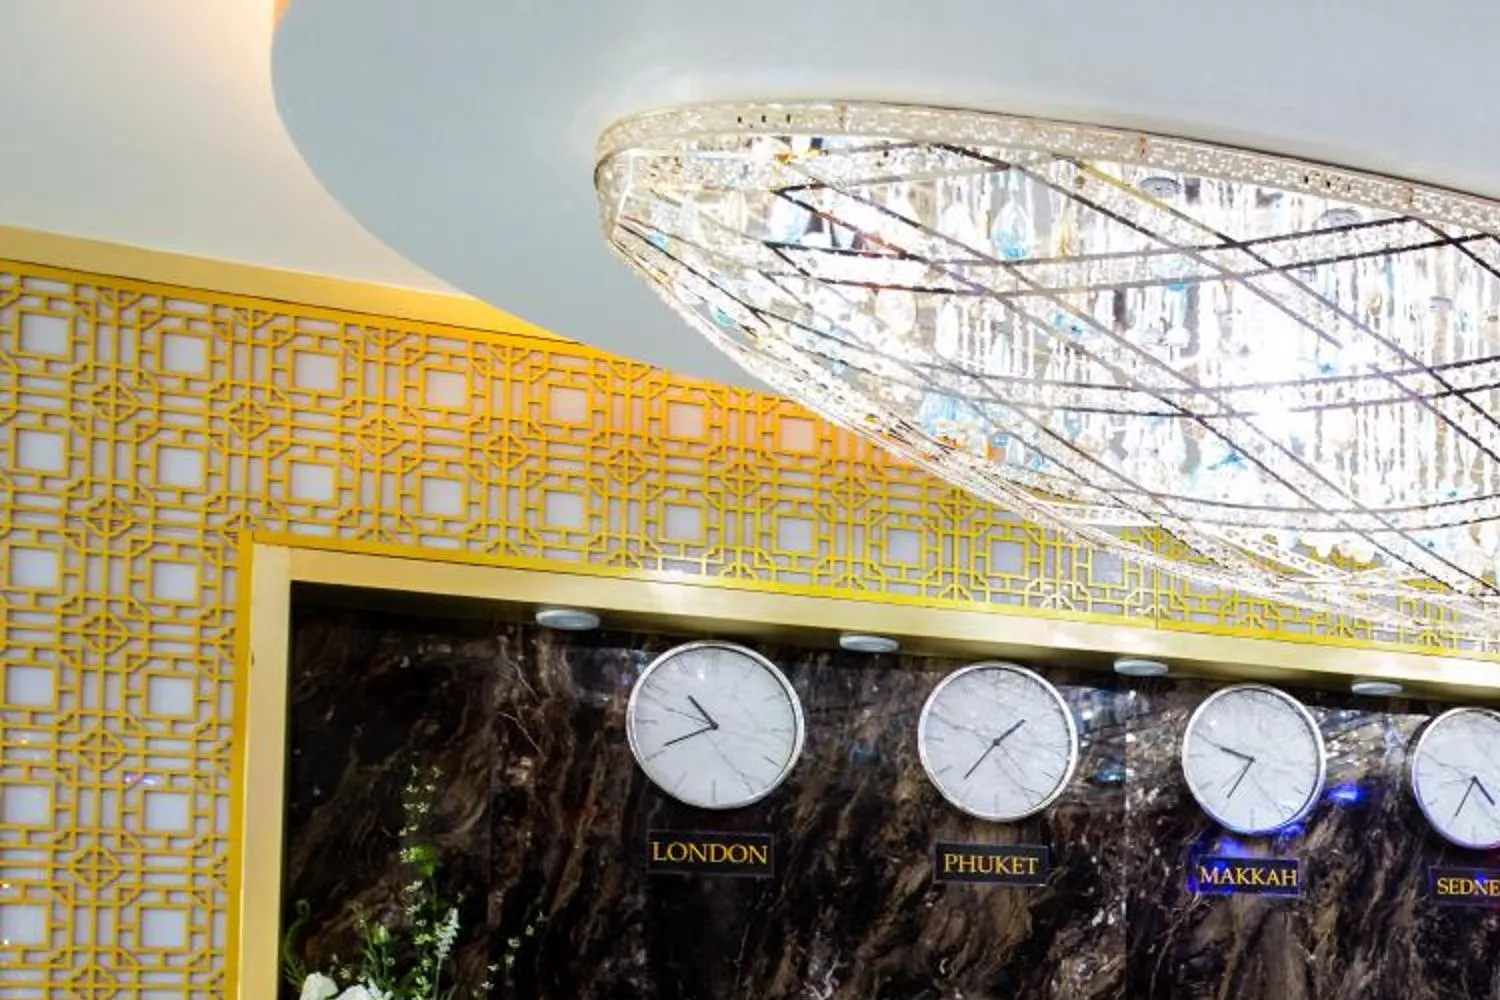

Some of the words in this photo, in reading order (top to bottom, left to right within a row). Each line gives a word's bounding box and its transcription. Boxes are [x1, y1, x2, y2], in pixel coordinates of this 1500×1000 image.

[651, 841, 768, 865] LONDON
[943, 853, 1039, 875] PHUKET
[1200, 865, 1297, 887] MAKKAH
